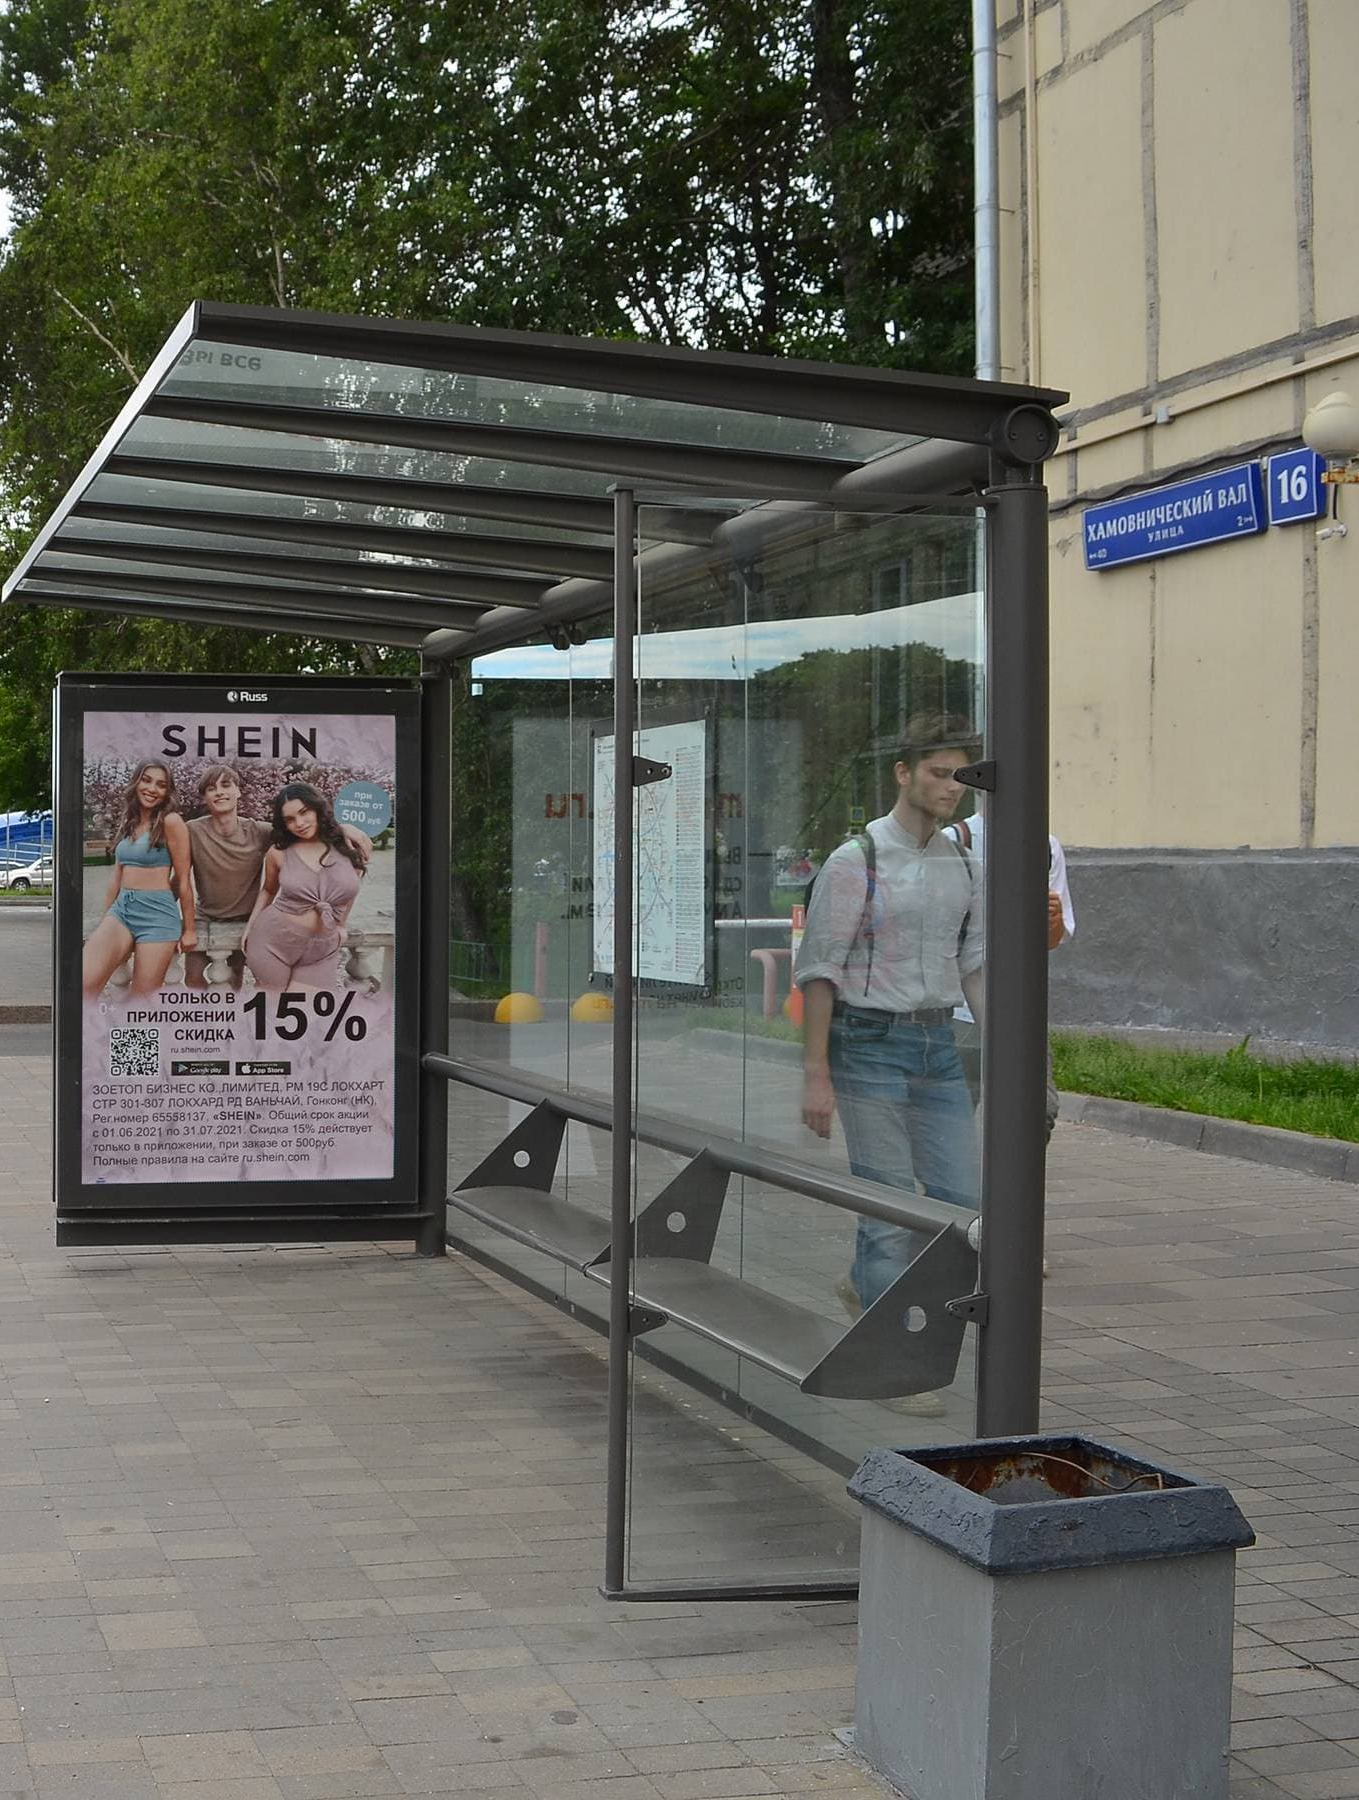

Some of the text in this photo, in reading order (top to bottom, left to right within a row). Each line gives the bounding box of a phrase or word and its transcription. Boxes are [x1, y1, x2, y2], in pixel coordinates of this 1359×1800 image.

[1277, 465, 1308, 504] 16
[1087, 483, 1248, 542] ХАМОВНИЧЕСКИЙ ВАЛ
[1147, 525, 1185, 544] УЛИЦА
[240, 691, 268, 701] Russ
[162, 724, 317, 758] SHEIN
[354, 792, 372, 800] при
[341, 809, 366, 822] 500
[159, 992, 235, 1004] ТОЛЬКО В
[127, 1011, 235, 1023] ПРИЛОЖЕНИИ
[243, 990, 367, 1042] 15%
[175, 1029, 235, 1042] СКИДКА
[171, 1045, 220, 1054] ru.shein.com
[93, 1084, 142, 1095] ЗОЕТОП
[146, 1083, 195, 1094] БИЗНЕС
[286, 1082, 303, 1092] РМ
[331, 1081, 384, 1091] ЛОКХАРТ
[93, 1099, 117, 1109] СТР
[121, 1098, 164, 1108] 301-307
[168, 1097, 224, 1108] ЛОКХАРД
[227, 1097, 242, 1107] РД
[307, 1096, 348, 1106] Гонконг
[269, 1110, 307, 1121] Общий
[310, 1112, 334, 1121] срок
[338, 1111, 369, 1120] акции
[102, 1127, 162, 1138] 01.06.2021
[166, 1128, 179, 1137] по
[250, 1124, 289, 1134] Скидка
[293, 1124, 315, 1134] 15%
[318, 1124, 373, 1135] действует
[93, 1143, 130, 1152] только
[134, 1143, 140, 1151] в
[144, 1141, 216, 1152] приложении,
[219, 1140, 239, 1151] при
[242, 1139, 278, 1149] заказе
[281, 1139, 293, 1148] от
[93, 1153, 310, 1166] Полные правила на сайте ru.shein.com
